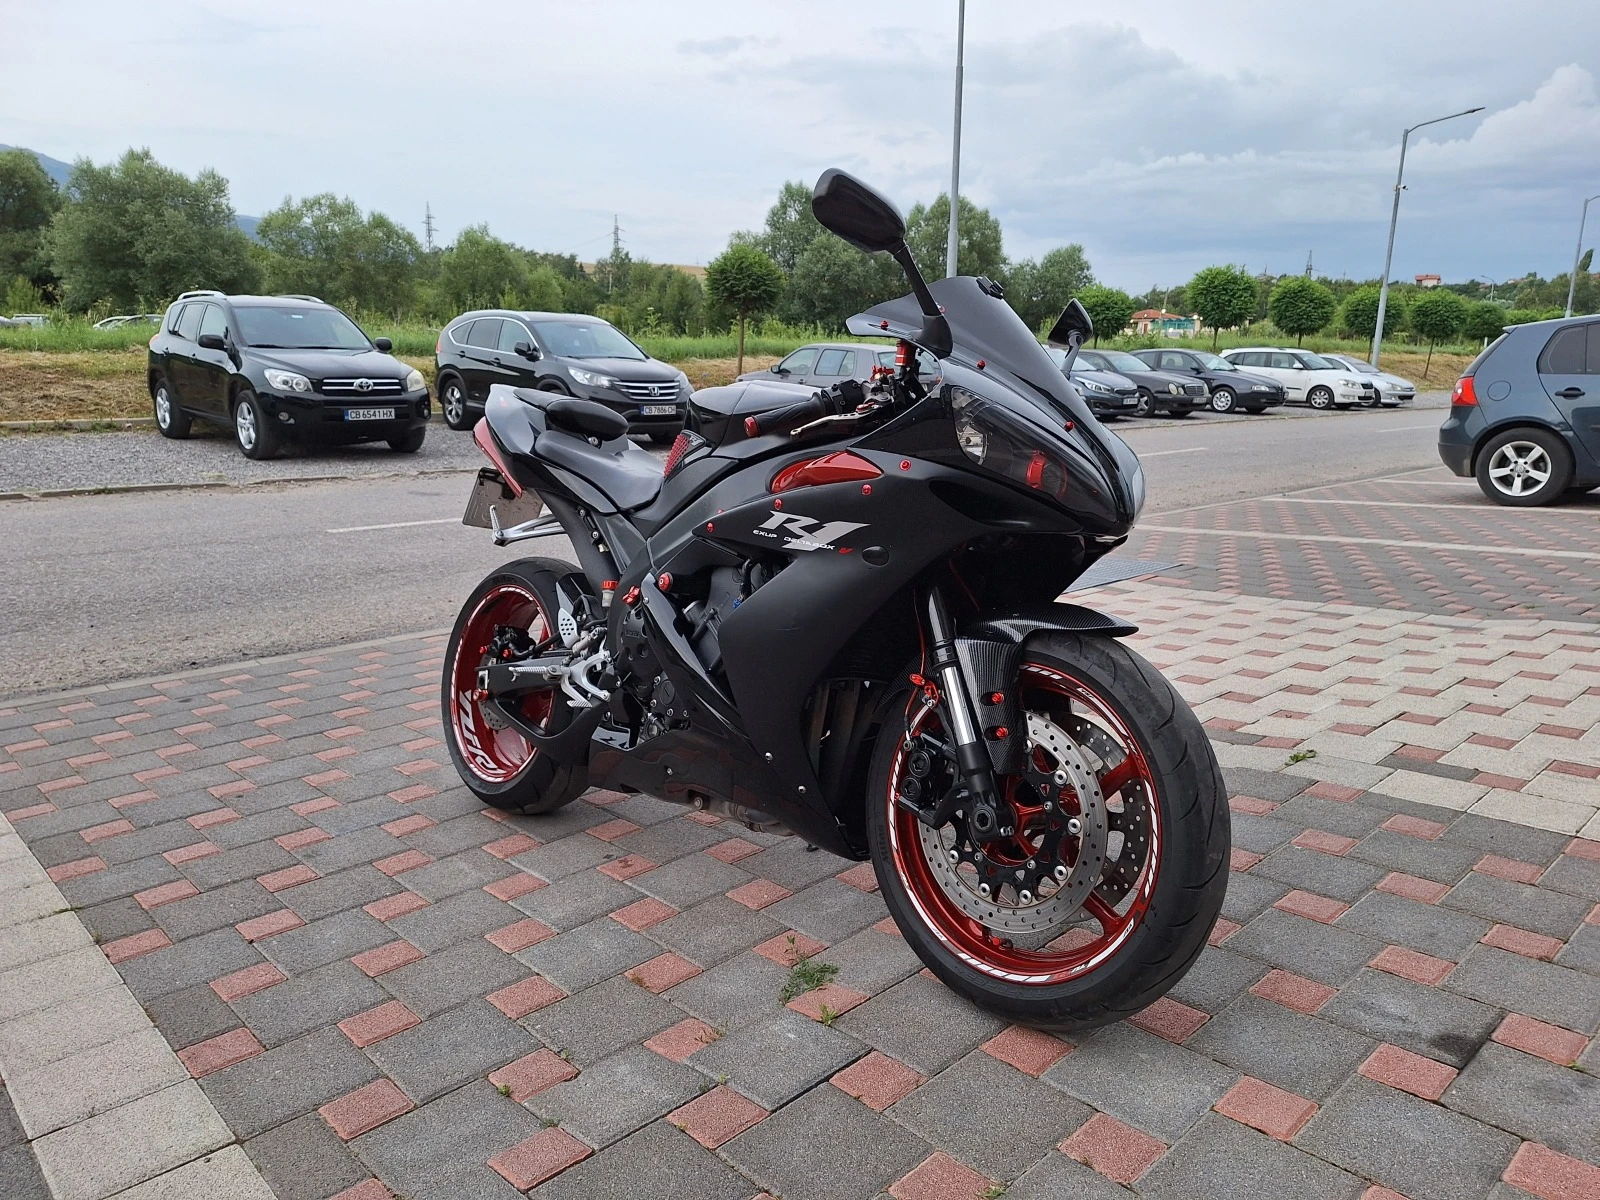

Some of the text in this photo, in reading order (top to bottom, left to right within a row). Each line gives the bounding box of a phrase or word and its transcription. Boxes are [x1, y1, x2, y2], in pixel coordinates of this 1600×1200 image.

[350, 409, 393, 419] CB 6541 HX
[752, 529, 778, 538] EXUP
[783, 535, 835, 550] DELTABOX
[757, 510, 872, 552] R1
